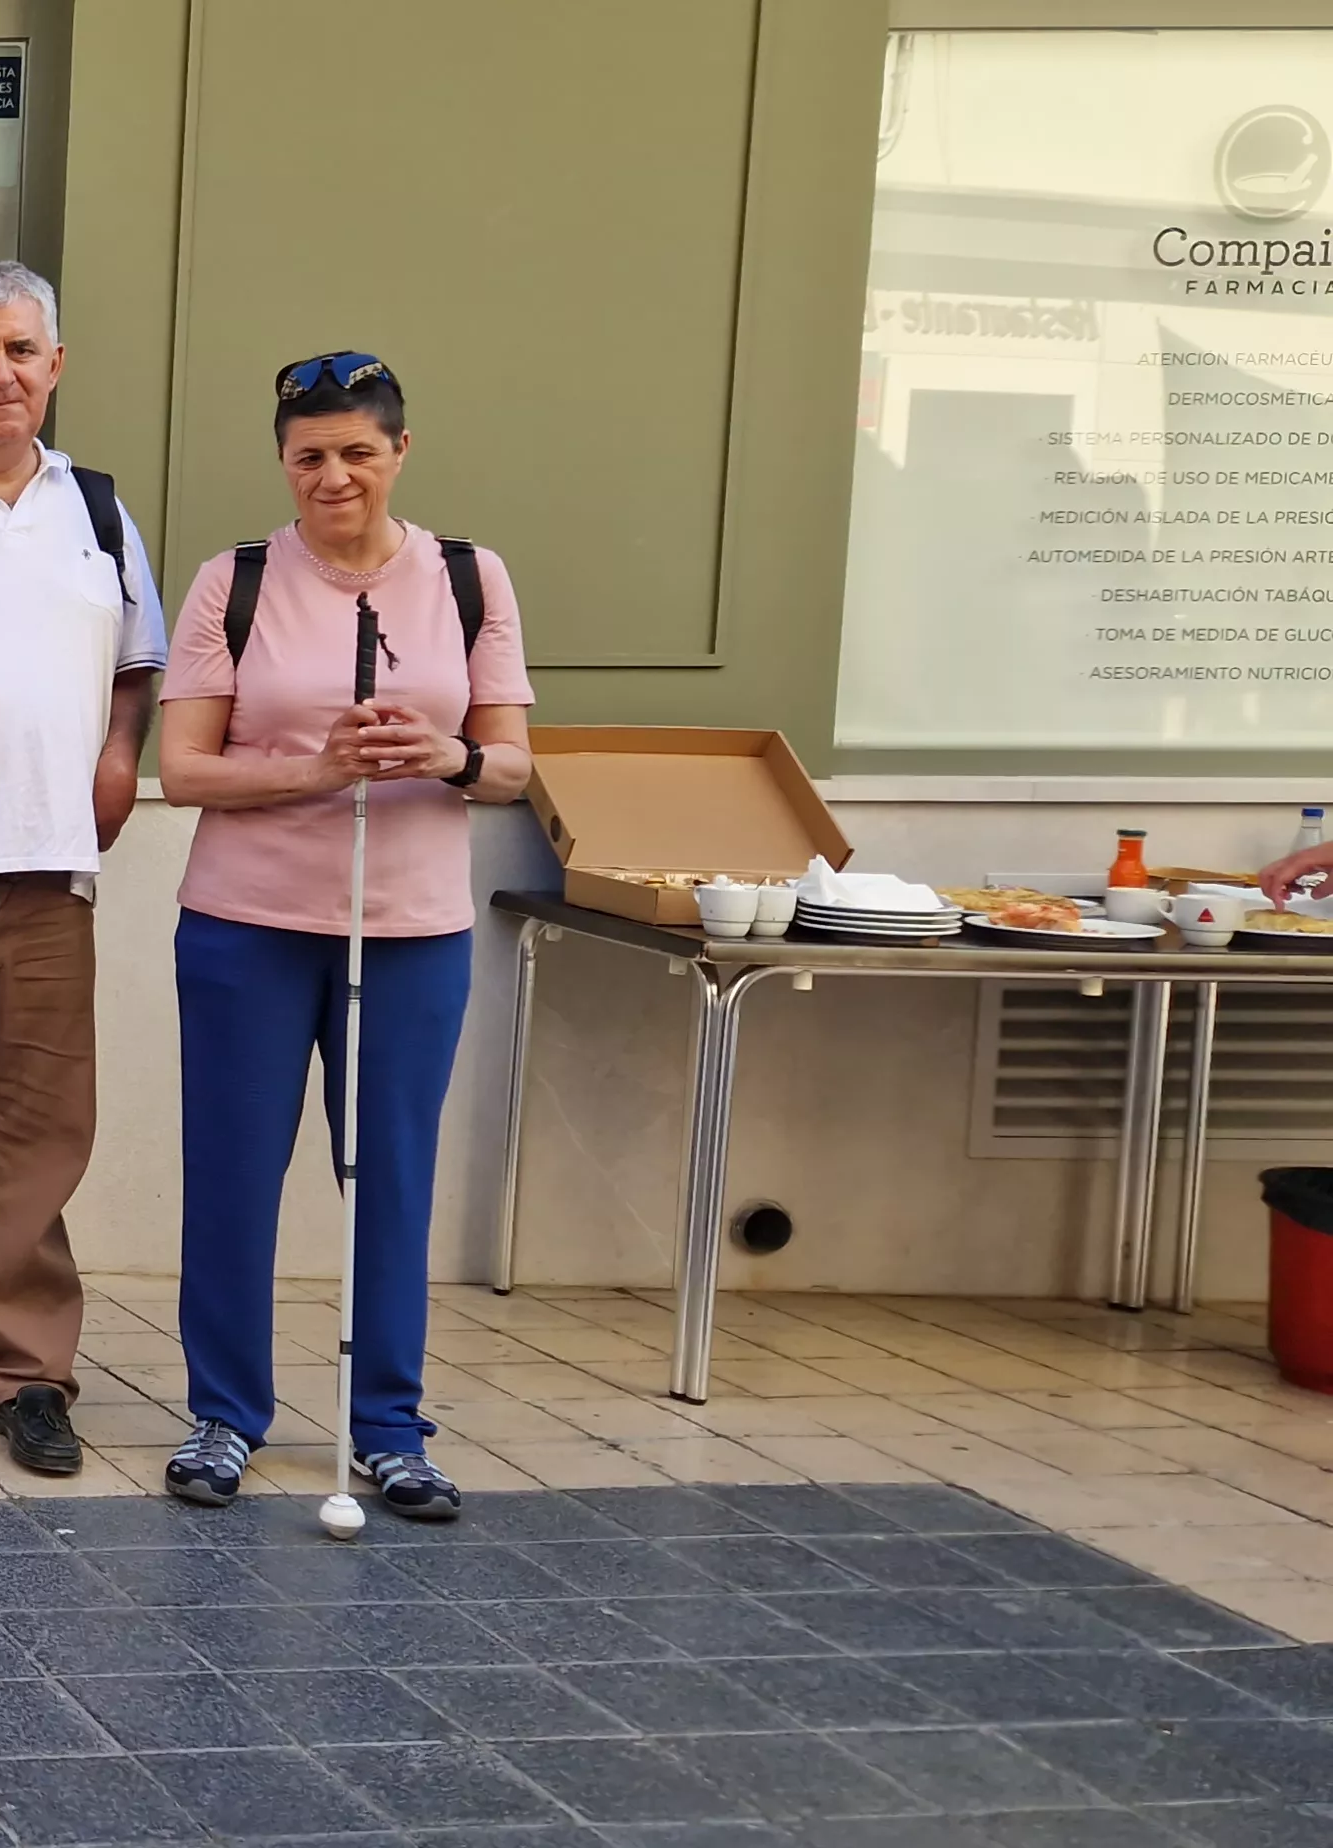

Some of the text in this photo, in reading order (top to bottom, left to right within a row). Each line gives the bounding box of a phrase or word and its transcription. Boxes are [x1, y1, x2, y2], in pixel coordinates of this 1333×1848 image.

[1186, 280, 1333, 295] FARMACIA
[1138, 350, 1228, 366] ATENCIÓN
[1168, 389, 1333, 406] DERMOCOSMÉTICA
[1048, 432, 1333, 445] SISTEMA PERSONALIZADO DE D
[1054, 468, 1137, 485] REVISIÓN
[1143, 471, 1166, 485] DE
[1173, 471, 1210, 485] USO
[1215, 471, 1239, 485] DE
[1039, 508, 1128, 524] MEDICIÓN
[1133, 510, 1211, 524] AISLADA
[1216, 510, 1240, 524] DE
[1246, 511, 1269, 524] LA
[1027, 549, 1146, 564] AUTOMEDIDA
[1152, 549, 1176, 563] DE
[1181, 550, 1204, 563] LA
[1209, 546, 1286, 564] PRESIÓN
[1101, 586, 1258, 602] DESHABITUACIÓN
[1095, 628, 1333, 642] TOMA DE MEDIDA DE GLUC
[1088, 666, 1333, 680] ASESORAMIENTO NUTRICIO
